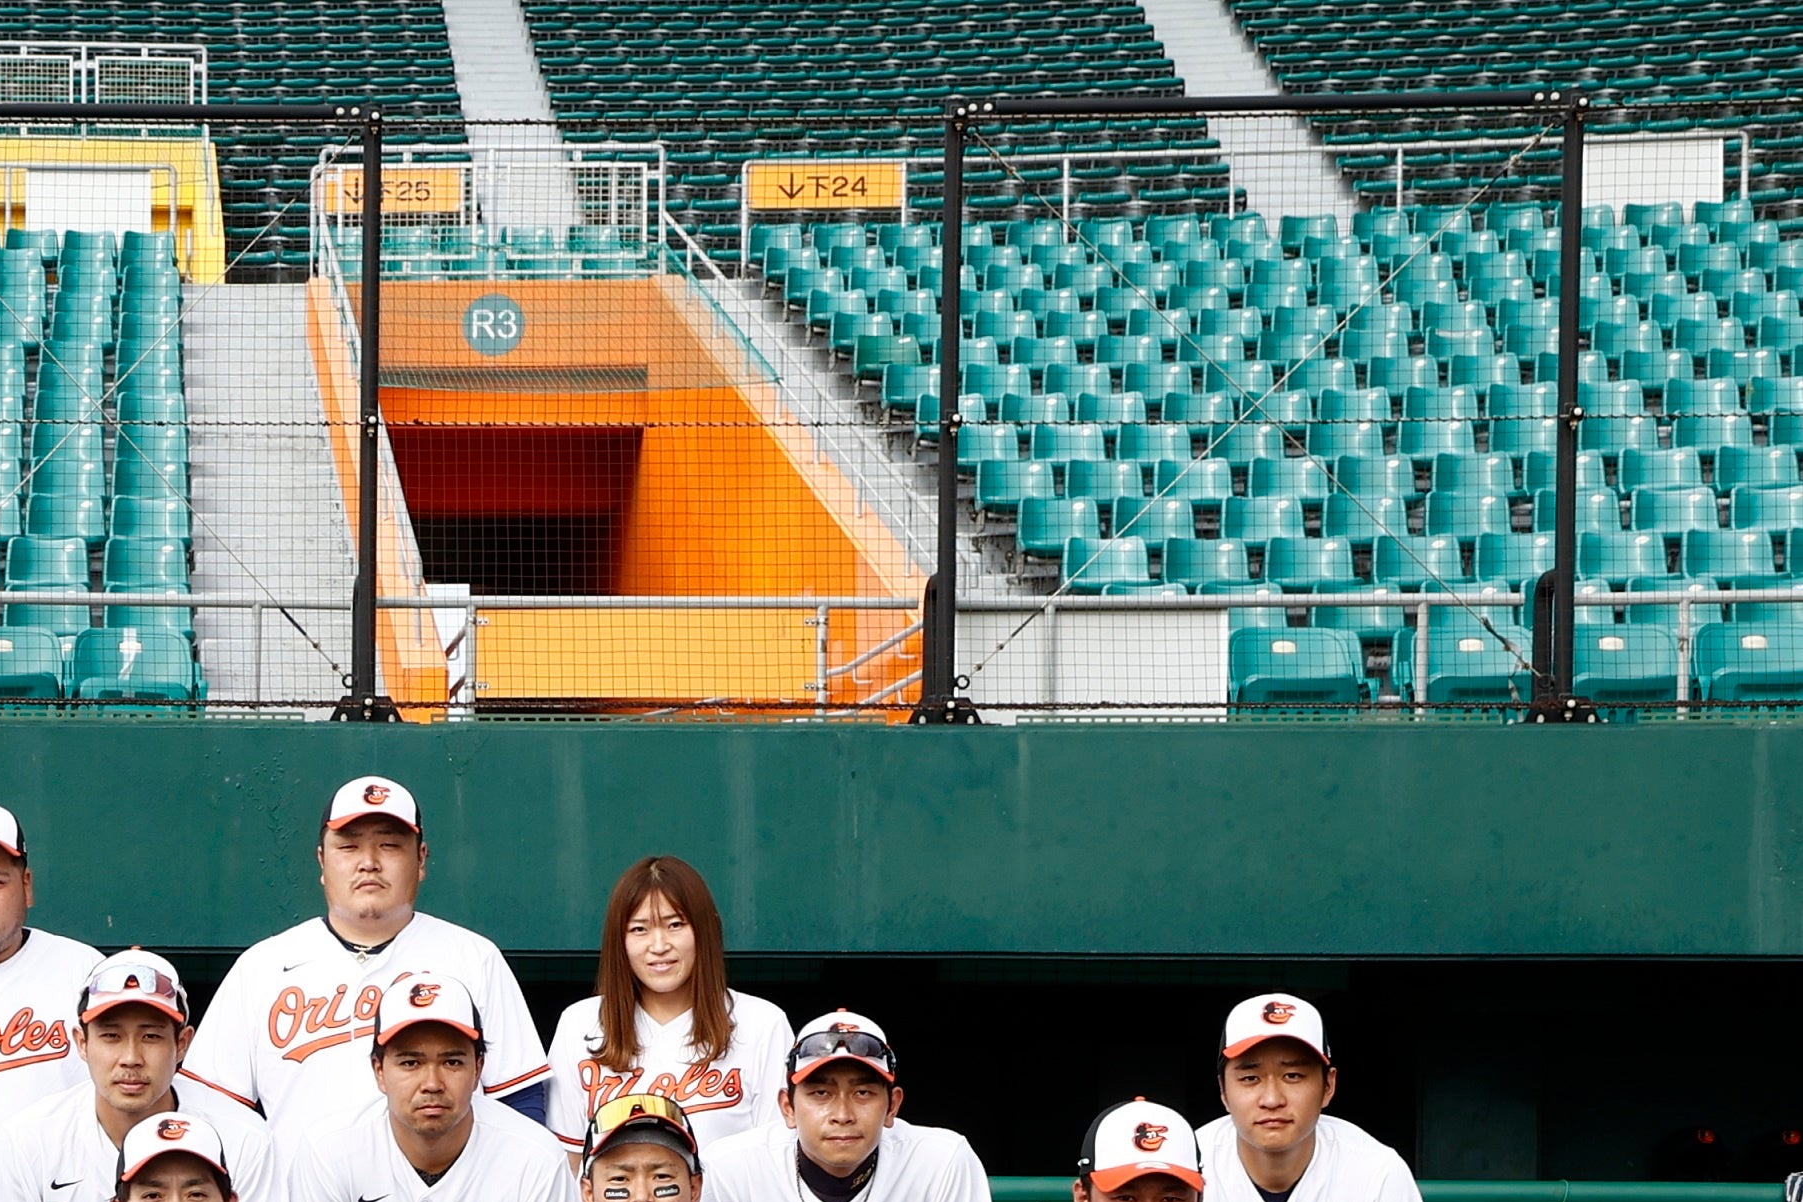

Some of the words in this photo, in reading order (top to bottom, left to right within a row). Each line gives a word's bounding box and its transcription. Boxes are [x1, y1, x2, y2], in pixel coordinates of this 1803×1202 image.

[806, 175, 868, 199] 下24
[471, 308, 518, 340] R3
[267, 971, 414, 1049] Orio
